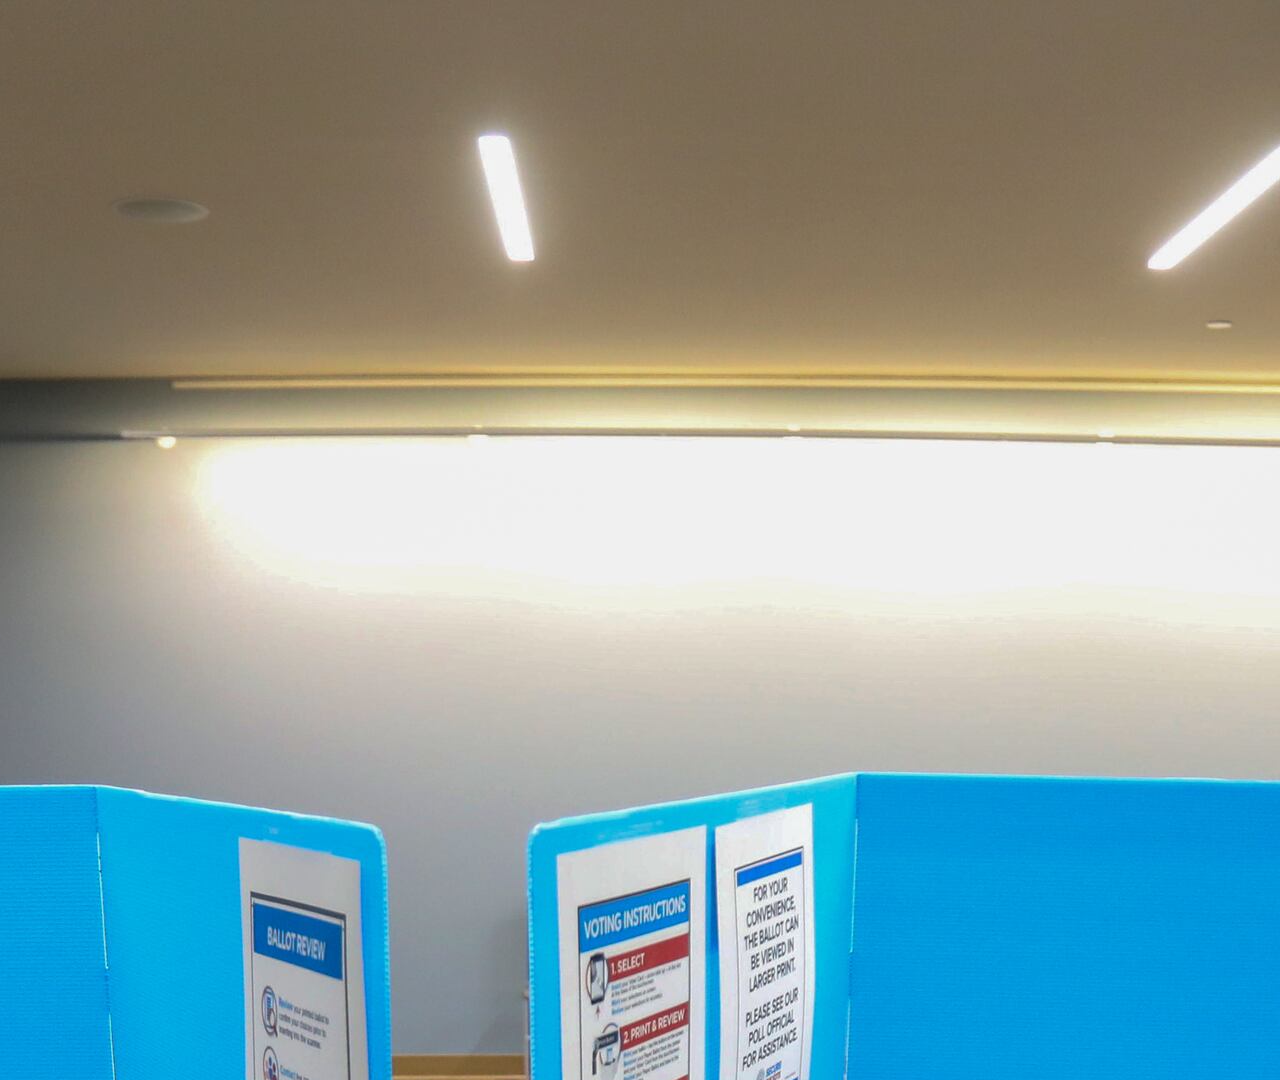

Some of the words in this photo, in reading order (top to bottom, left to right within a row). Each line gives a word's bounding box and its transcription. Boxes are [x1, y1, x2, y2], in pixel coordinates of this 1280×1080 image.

[753, 884, 768, 903] FOR
[769, 877, 788, 898] YOUR
[584, 911, 622, 940] VOTING
[623, 895, 686, 929] INSTRUCTIONS
[746, 895, 796, 928] CONVENIENCE,
[267, 925, 296, 952] BALLOT
[296, 933, 326, 961] REVIEW
[744, 933, 758, 952] THE
[759, 921, 784, 945] BALLOT
[785, 914, 799, 932] CAN
[617, 953, 645, 972] SELECT
[751, 952, 760, 970] BE
[760, 941, 787, 965] VIEWED
[787, 937, 795, 952] IN
[749, 966, 776, 993] LARGER
[776, 957, 795, 980] PRINT.
[631, 1021, 651, 1041] PRINT
[652, 1019, 657, 1032] &
[658, 1008, 685, 1029] REVIEW
[745, 1001, 771, 1027] PLEASE
[771, 995, 783, 1014] SEE
[784, 987, 799, 1006] OUR
[748, 1027, 765, 1047] POLL
[767, 1009, 794, 1037] OFFICIAL
[742, 1053, 756, 1071] FOR
[757, 1028, 798, 1063] ASSISTANCE
